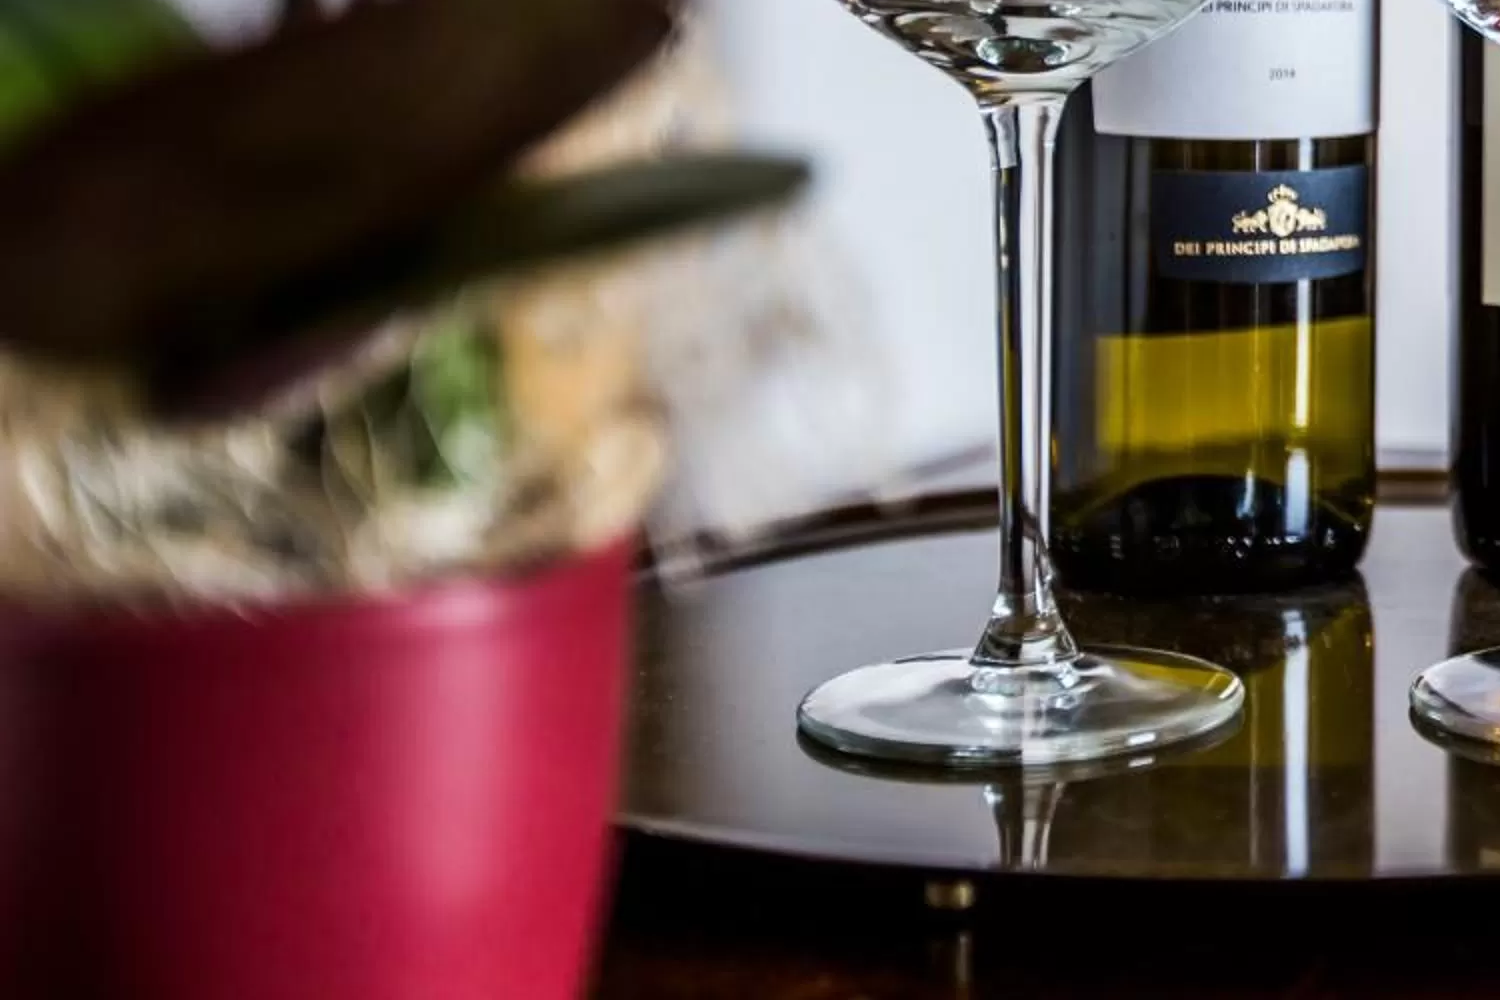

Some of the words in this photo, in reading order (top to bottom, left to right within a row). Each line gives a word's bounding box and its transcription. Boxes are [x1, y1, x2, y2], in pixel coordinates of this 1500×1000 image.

[1173, 241, 1201, 256] DEI
[1205, 239, 1276, 256] PRINCIPI
[1279, 239, 1297, 255] DI
